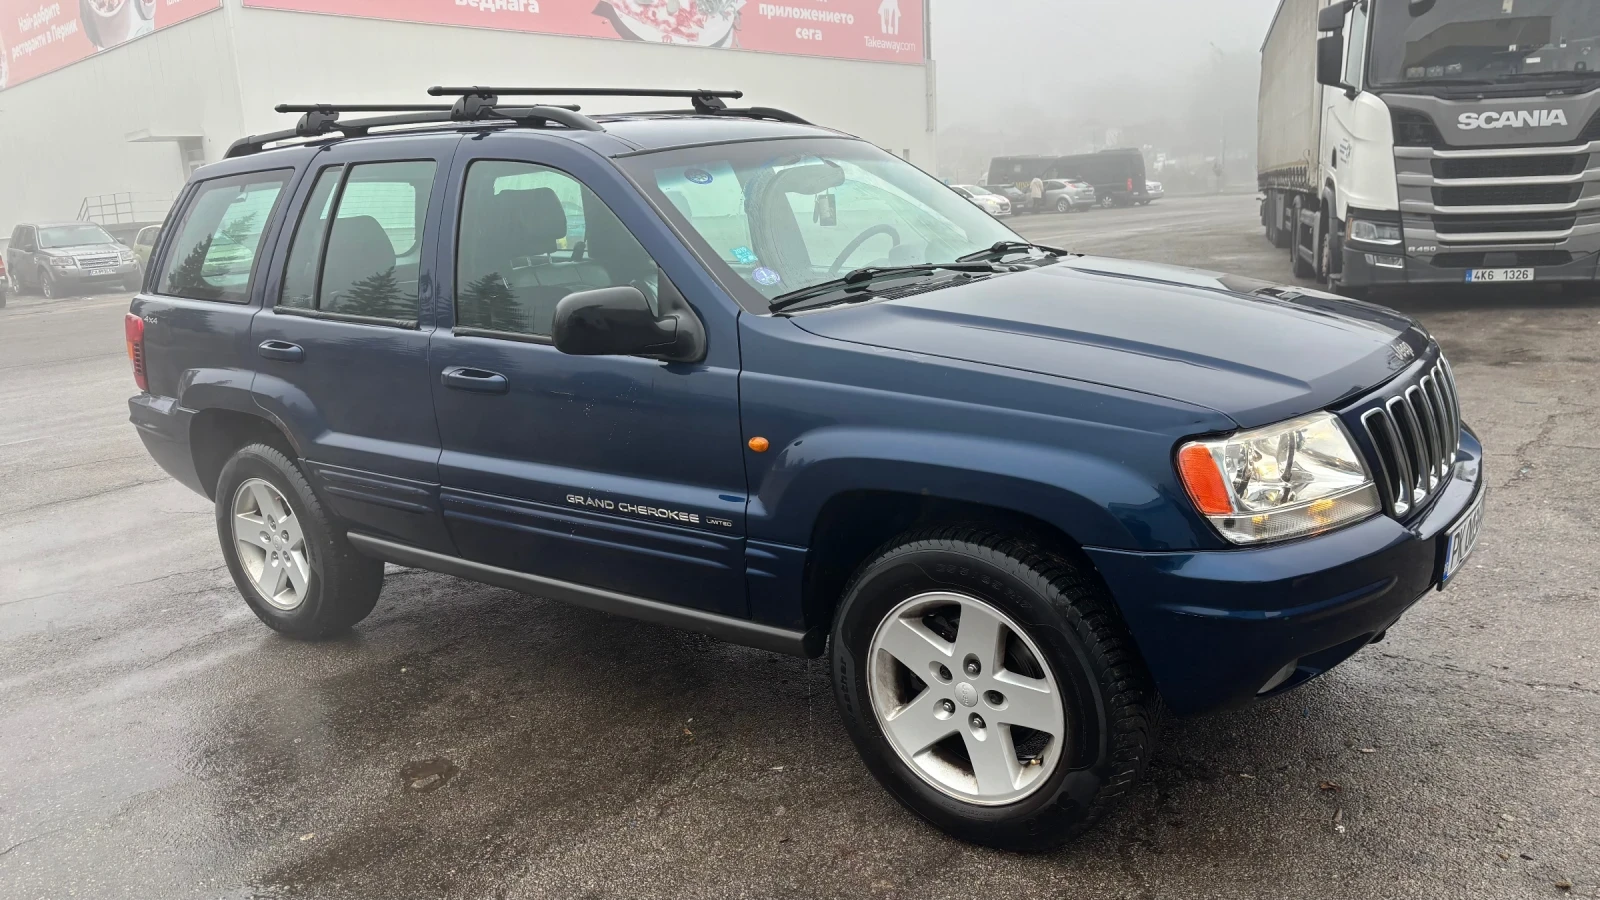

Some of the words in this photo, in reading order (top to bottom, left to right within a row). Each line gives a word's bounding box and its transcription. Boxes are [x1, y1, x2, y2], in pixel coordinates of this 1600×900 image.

[17, 2, 61, 33] Най-добрите
[758, 3, 855, 25] приложението
[11, 33, 47, 62] ресторанти
[46, 31, 52, 43] в
[50, 18, 78, 43] Перник
[795, 27, 823, 41] сега
[863, 35, 916, 53] Takeaway.com
[1457, 109, 1568, 130] SCANIA
[1474, 270, 1494, 280] 4K6
[1502, 269, 1529, 280] 1326
[566, 493, 615, 510] GRAND
[618, 502, 700, 523] CHEROKEE
[706, 518, 733, 527] LIMITED
